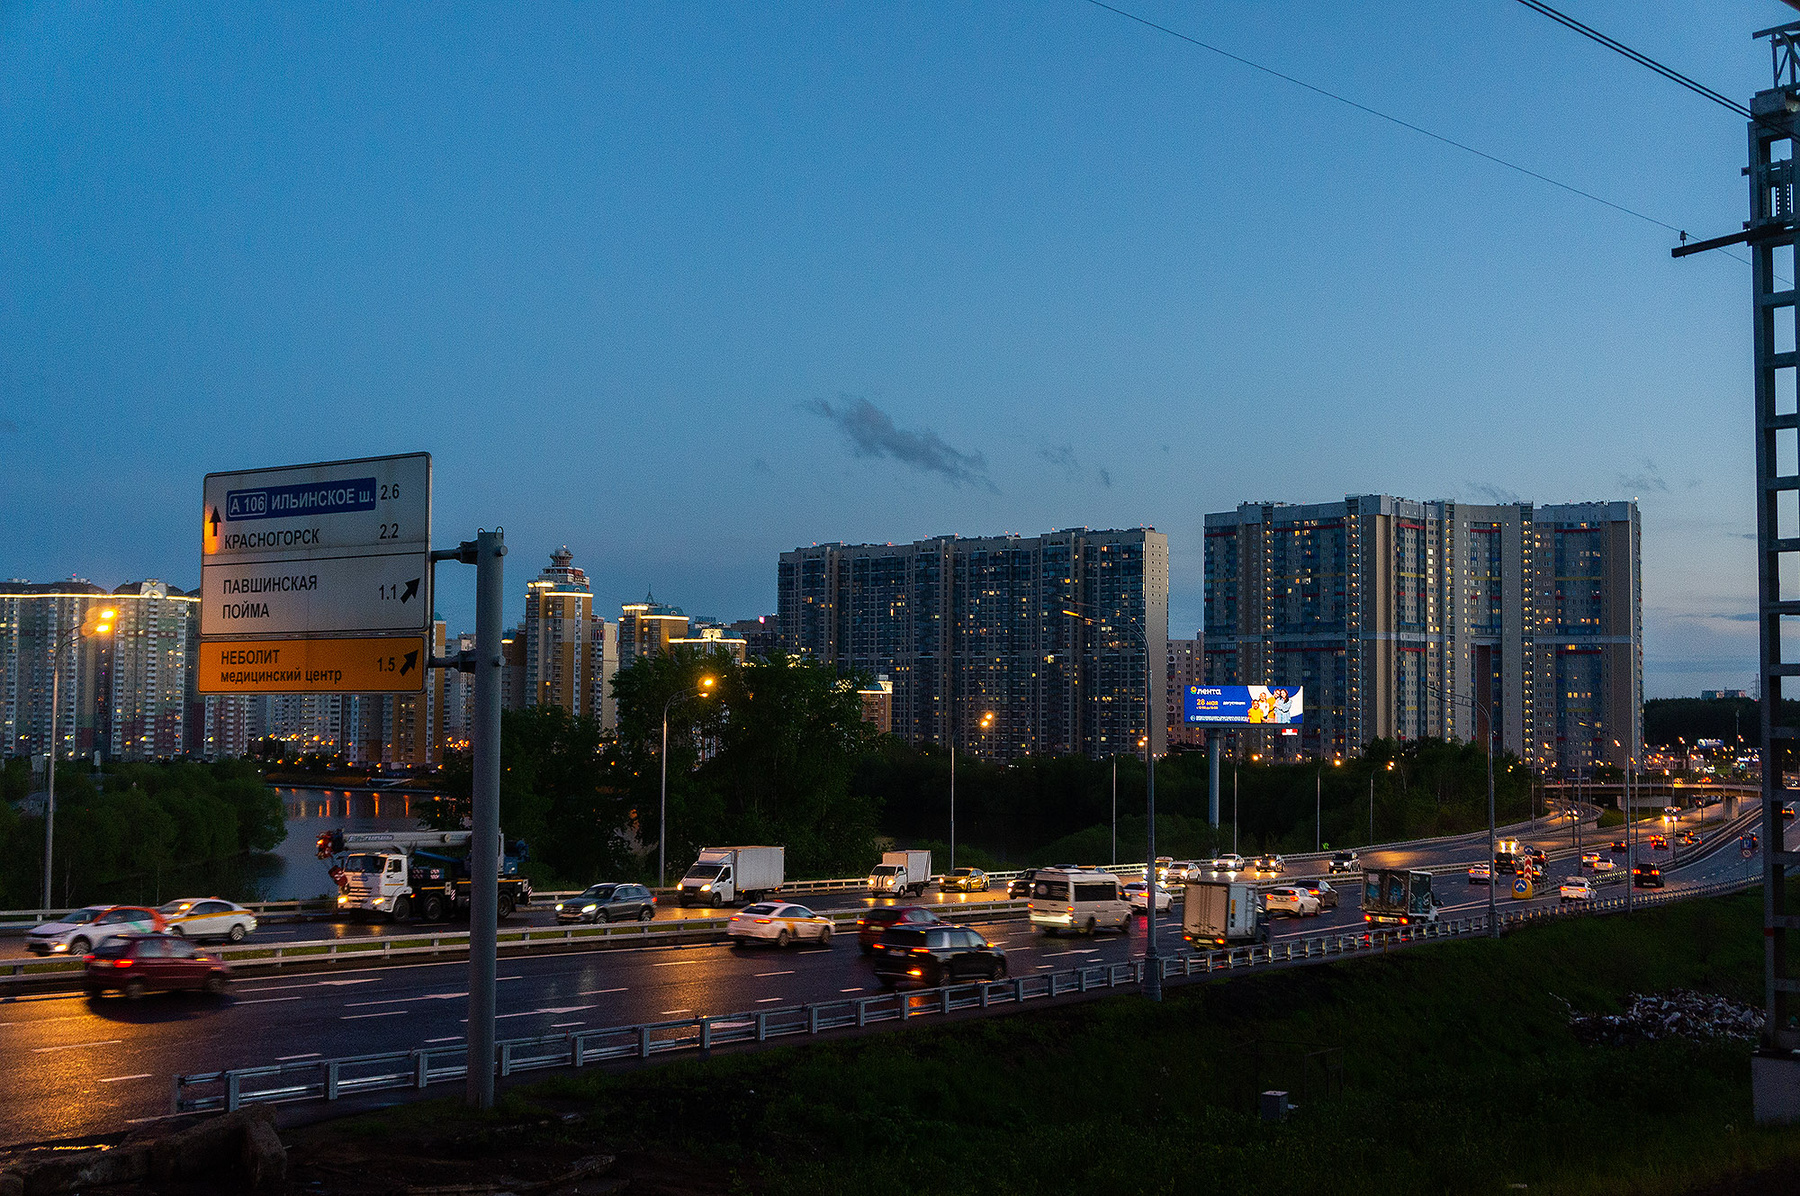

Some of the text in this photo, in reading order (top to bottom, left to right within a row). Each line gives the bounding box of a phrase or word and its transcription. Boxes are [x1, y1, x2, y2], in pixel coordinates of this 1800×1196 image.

[244, 496, 265, 512] 106
[271, 488, 355, 510] ИЛЬИНСКОЕ
[359, 491, 374, 503] ш.
[380, 483, 400, 500] 2.6
[224, 528, 320, 550] КРАСНОГОРСК
[379, 523, 399, 539] 2.2
[223, 575, 318, 594] ПАВШИНСКАЯ
[378, 584, 397, 600] 1.1
[222, 600, 270, 619] ПОЙМА
[221, 649, 280, 665] НЕБОЛИТ
[377, 657, 396, 672] 1.5
[220, 667, 342, 685] медицинский центр
